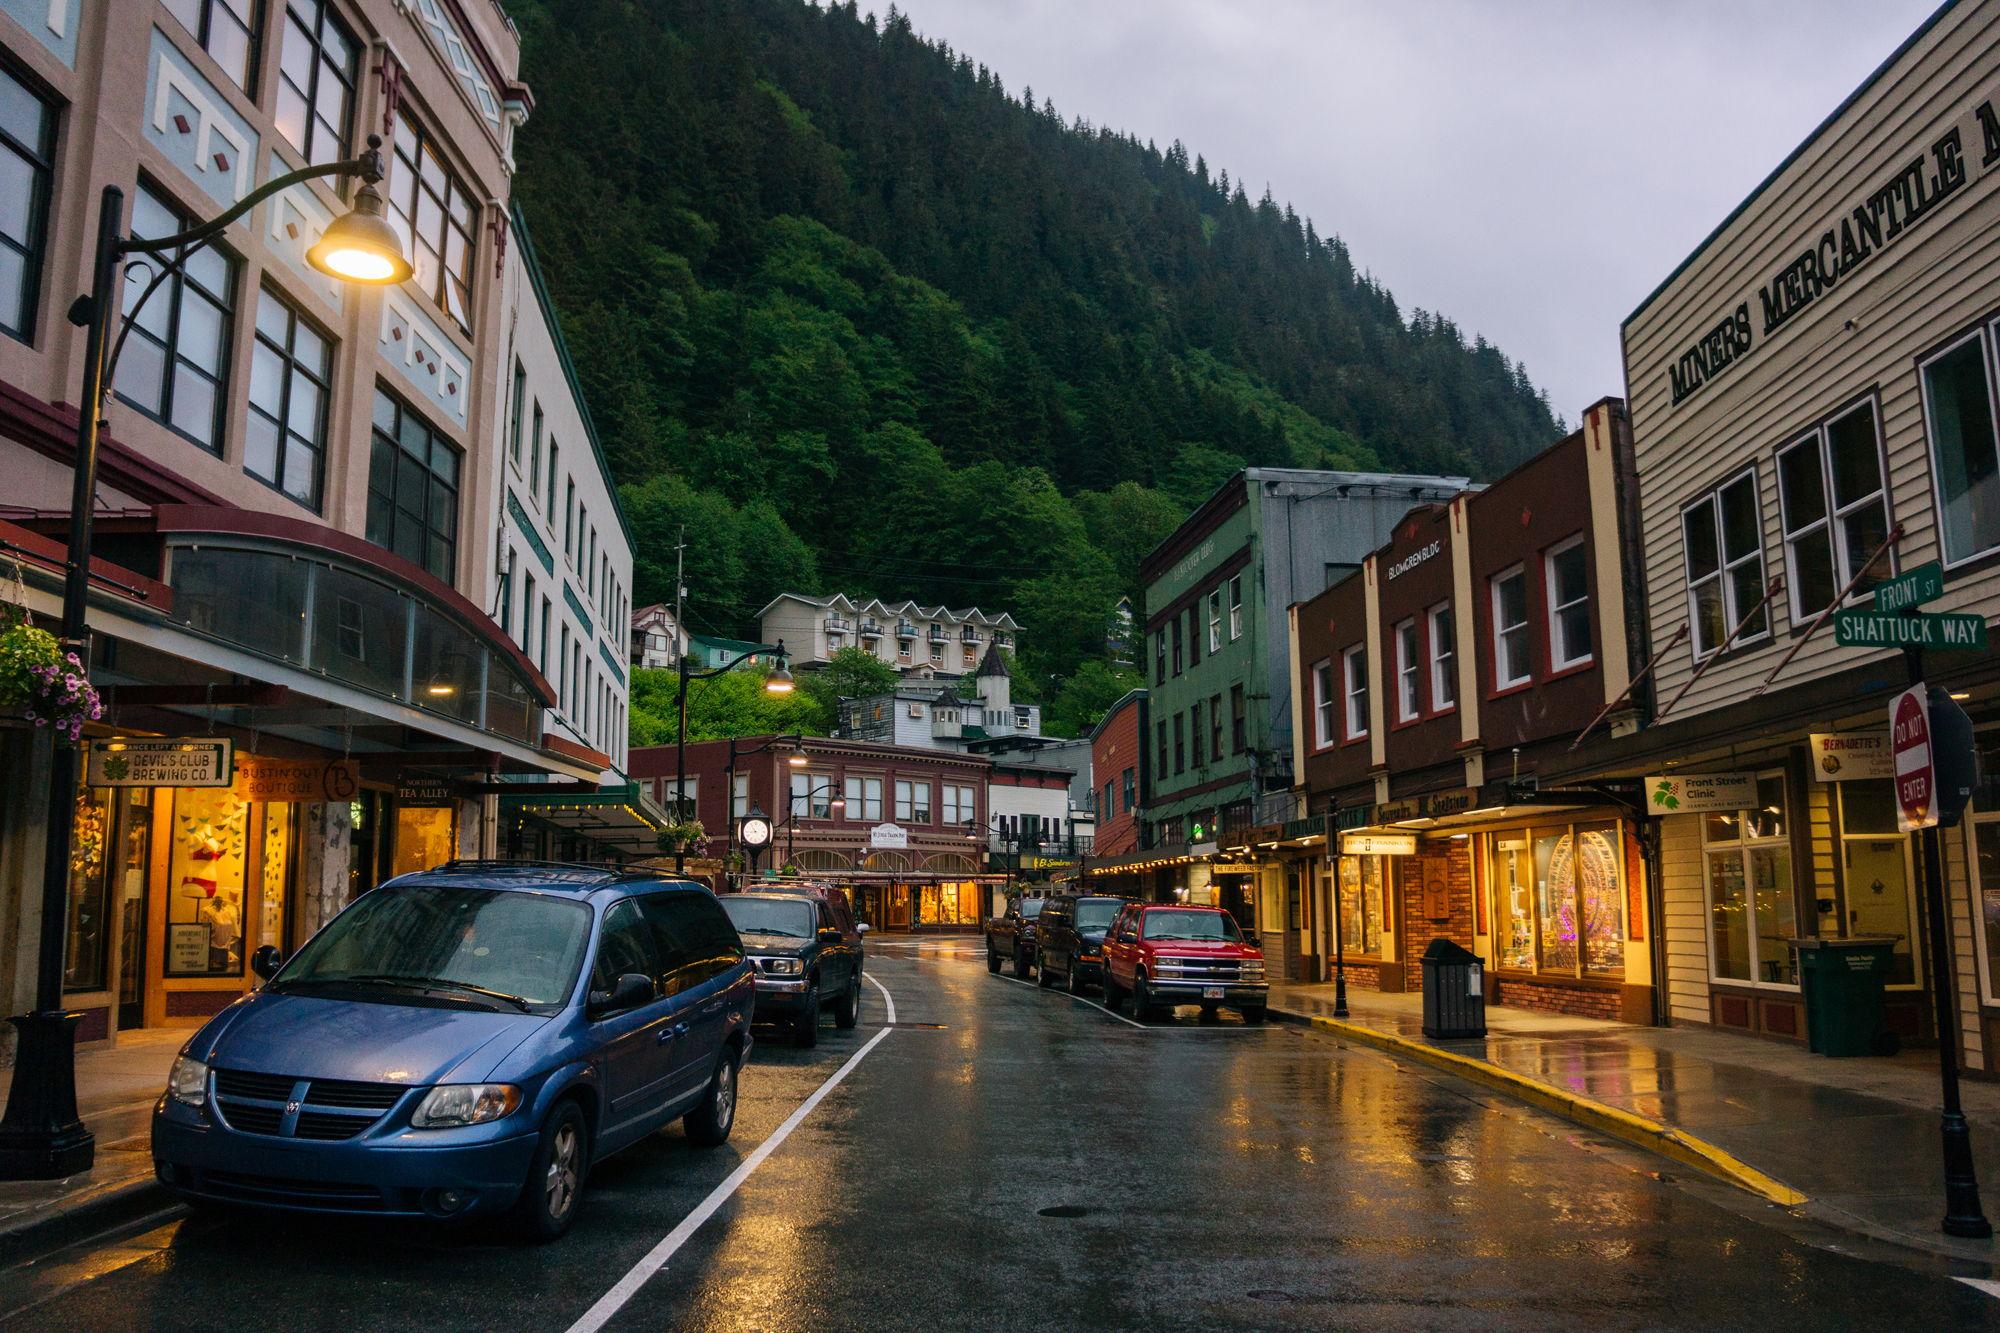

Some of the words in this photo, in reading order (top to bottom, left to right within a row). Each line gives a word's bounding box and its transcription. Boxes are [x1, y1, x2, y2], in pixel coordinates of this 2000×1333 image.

[1668, 301, 1752, 408] MINERS
[1758, 126, 1966, 337] MERCANTILE
[1881, 577, 1918, 611] FRONT
[1925, 579, 1935, 597] ST
[1841, 616, 1933, 643] SHATTUCK
[1942, 619, 1978, 644] WAY
[1896, 722, 1907, 745] DO
[1908, 714, 1923, 739] NOT
[1823, 737, 1881, 750] BERNADETTE'S
[134, 754, 176, 767] DEVIL'S
[179, 754, 210, 767] CLUB
[132, 768, 188, 781] BREWING
[191, 768, 209, 781] CO.
[1685, 779, 1713, 787] Front
[1715, 775, 1747, 786] Street
[249, 782, 313, 794] BOUTIQUE
[399, 788, 416, 798] TEA
[419, 788, 449, 798] ALLEY
[1686, 789, 1715, 799] Clinic
[1903, 777, 1927, 802] ENTER
